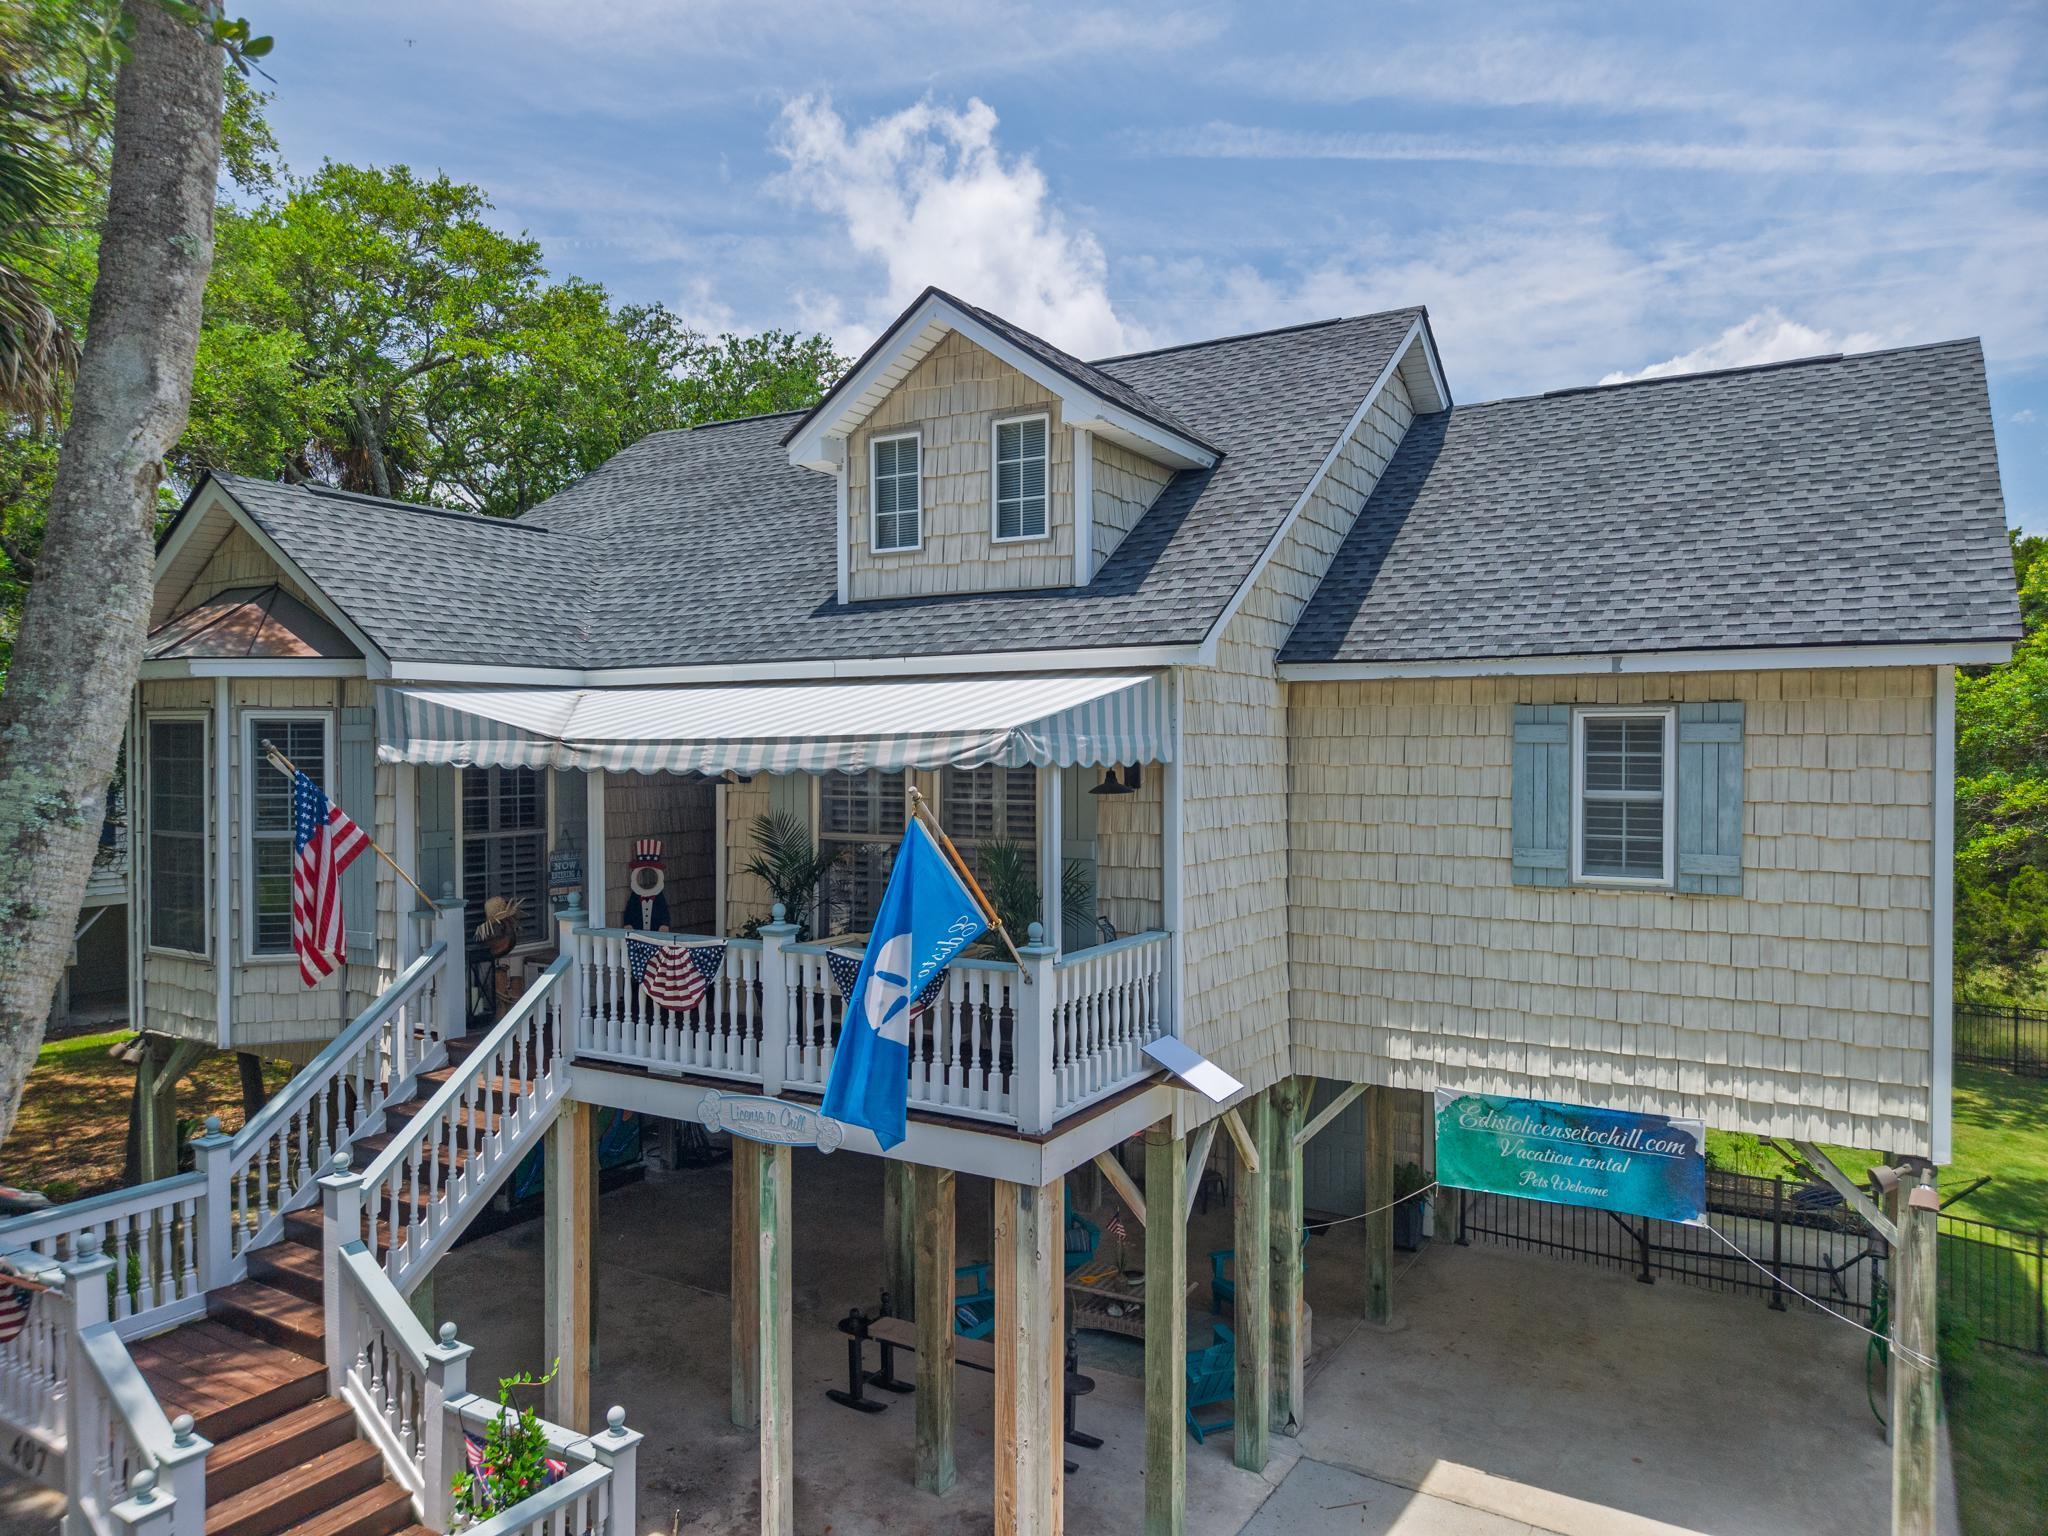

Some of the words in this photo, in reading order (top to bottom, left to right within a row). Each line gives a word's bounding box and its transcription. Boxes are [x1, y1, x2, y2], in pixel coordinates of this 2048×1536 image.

[730, 1103, 764, 1121] License
[766, 1109, 776, 1125] to
[780, 1106, 807, 1132] Chill
[1458, 1103, 1686, 1156] Edistolicensetochill.com
[1499, 1138, 1574, 1166] Vacation
[1578, 1157, 1632, 1174] rental
[1519, 1170, 1549, 1188] Pets
[1550, 1173, 1610, 1197] Welcome
